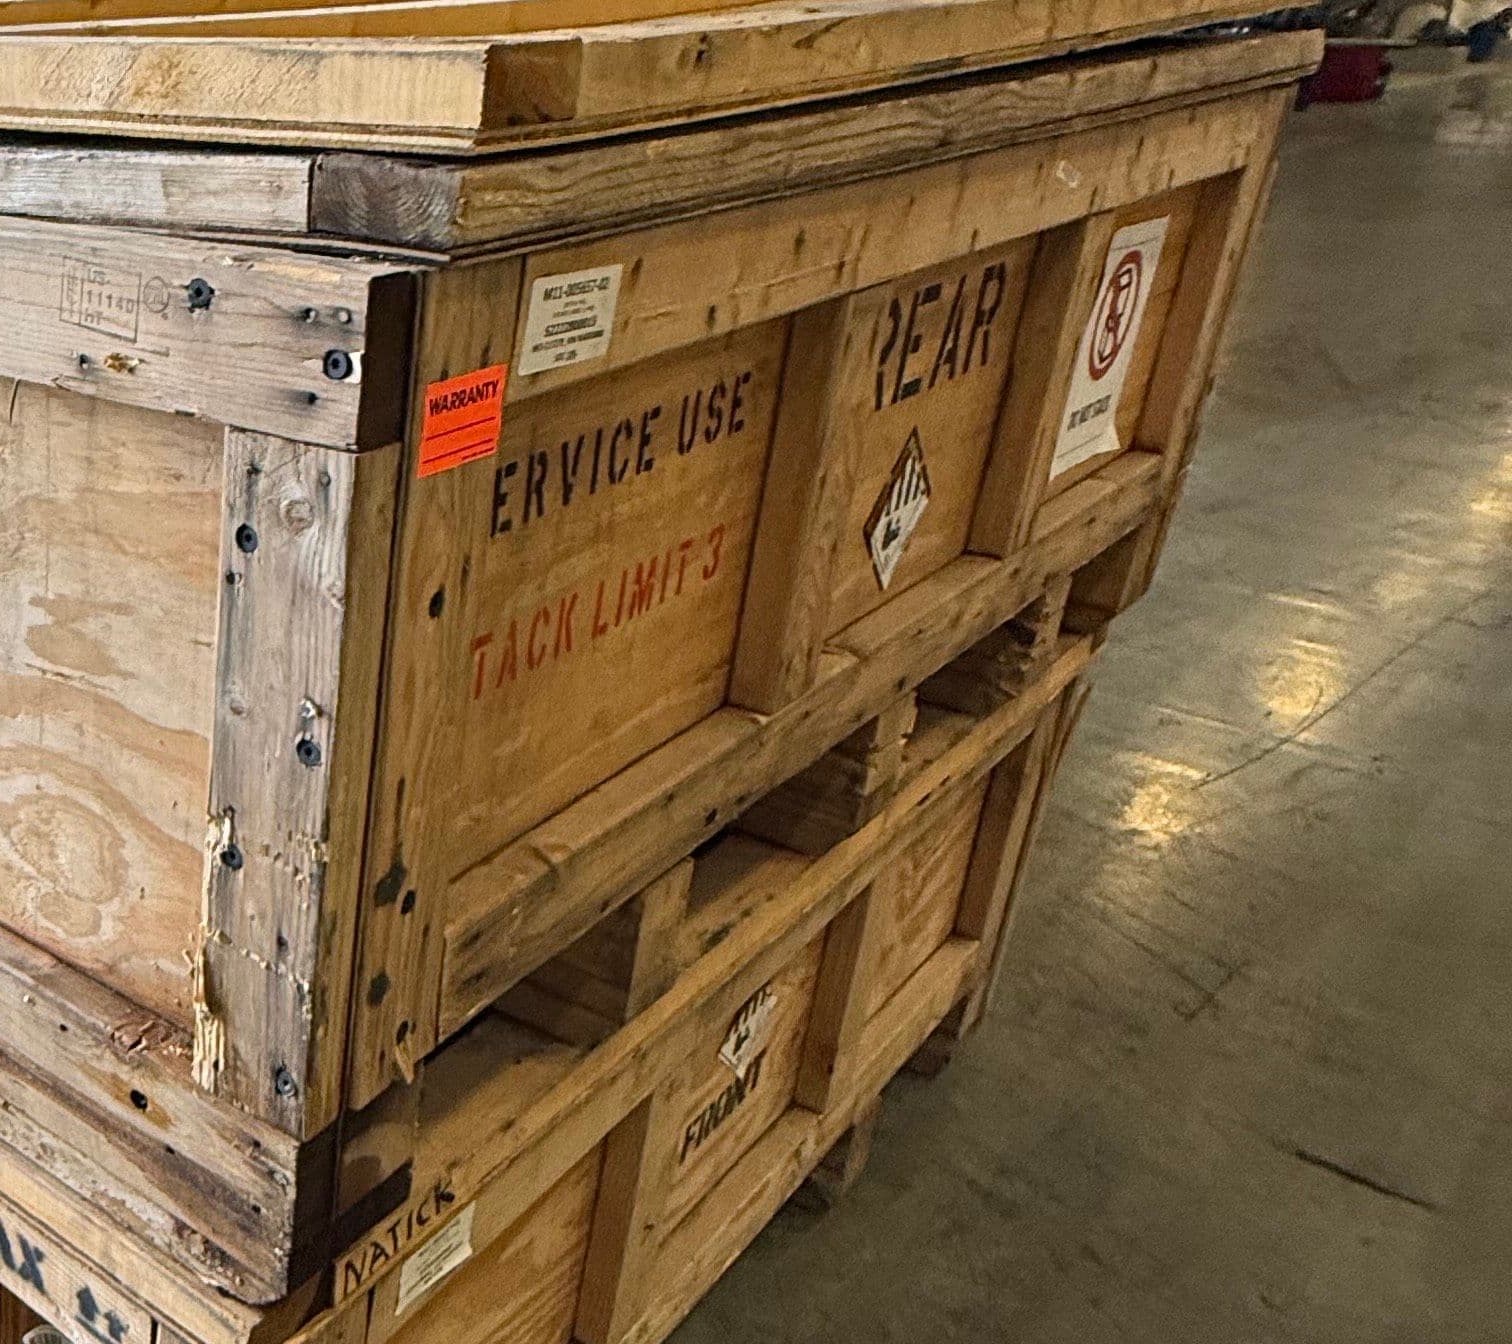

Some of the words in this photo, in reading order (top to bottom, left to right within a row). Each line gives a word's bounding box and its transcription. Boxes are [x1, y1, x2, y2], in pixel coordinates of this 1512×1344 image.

[429, 379, 499, 416] WARRANTY
[491, 405, 662, 538] ERVICE
[677, 371, 751, 455] USE
[470, 592, 579, 700] TACK
[592, 537, 693, 639] LIMIT
[679, 1046, 767, 1166] FRONT
[343, 1179, 455, 1301] NATICK
